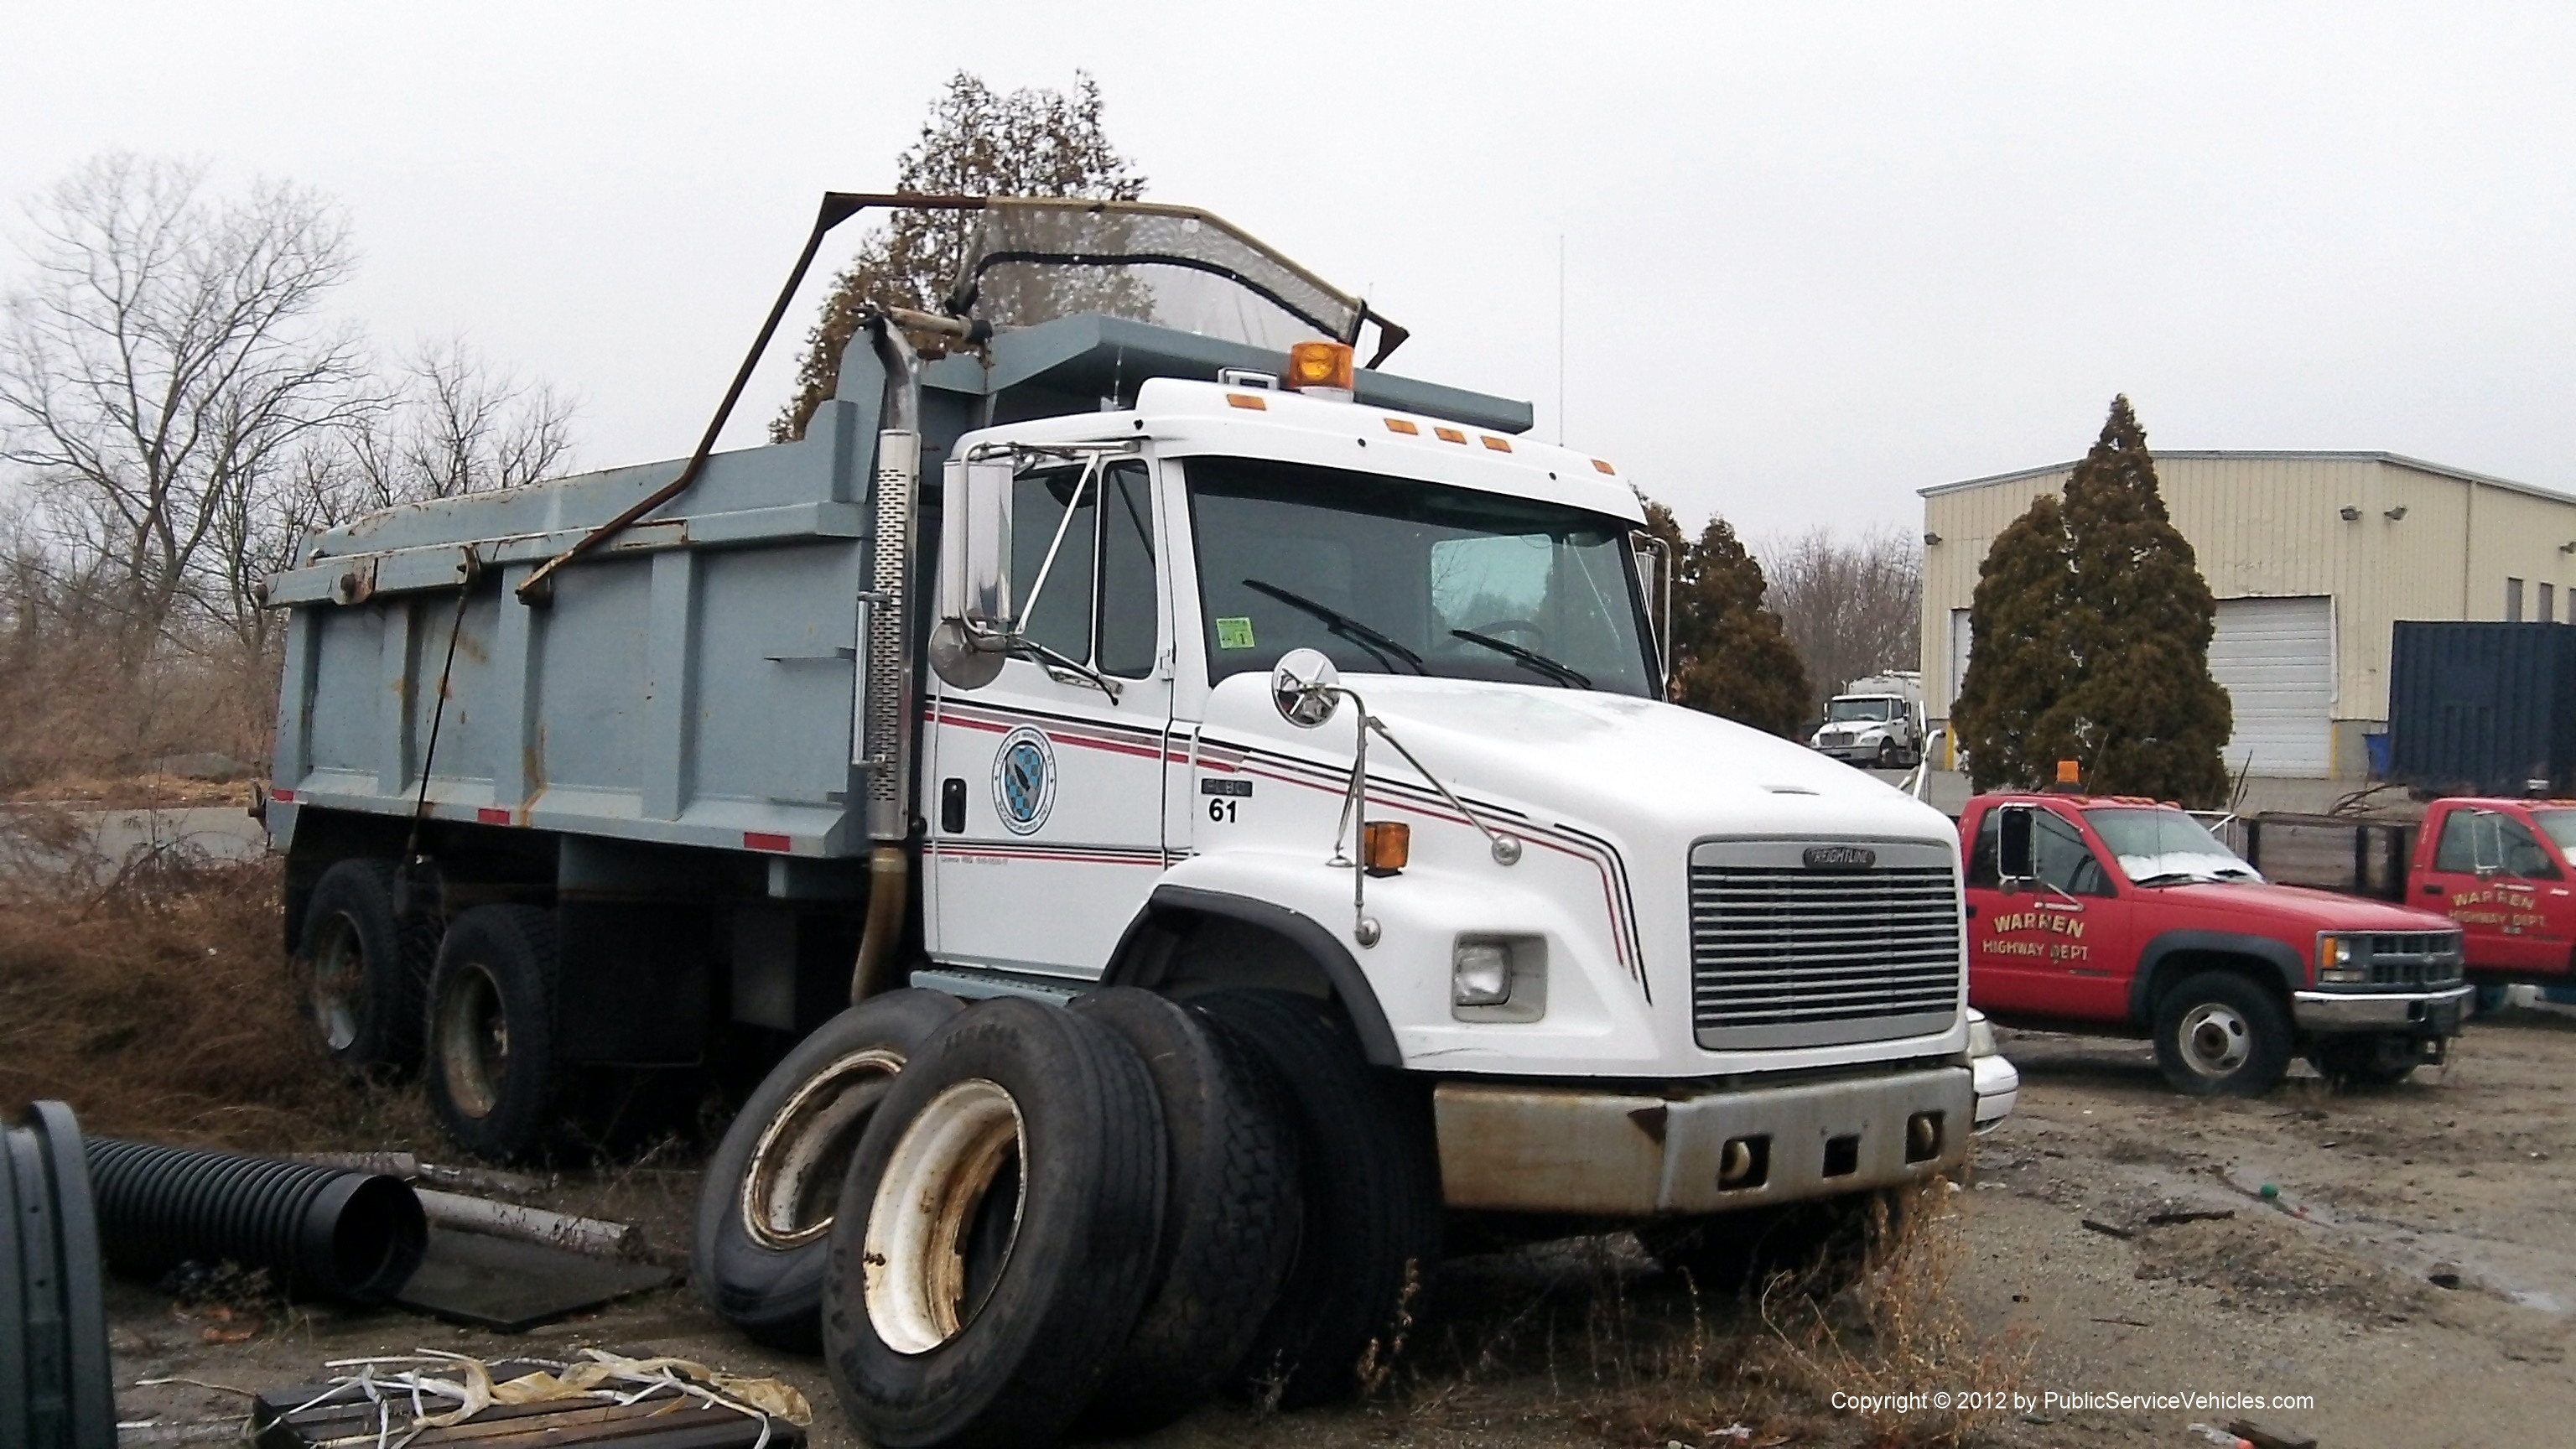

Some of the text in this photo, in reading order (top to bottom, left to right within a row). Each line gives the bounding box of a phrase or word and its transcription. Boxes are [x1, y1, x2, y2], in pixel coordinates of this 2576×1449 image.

[1209, 798, 1236, 823] 61
[2453, 891, 2535, 911] WARREN
[1994, 913, 2085, 938] WARREN
[1982, 939, 2045, 955] HIGHWAY
